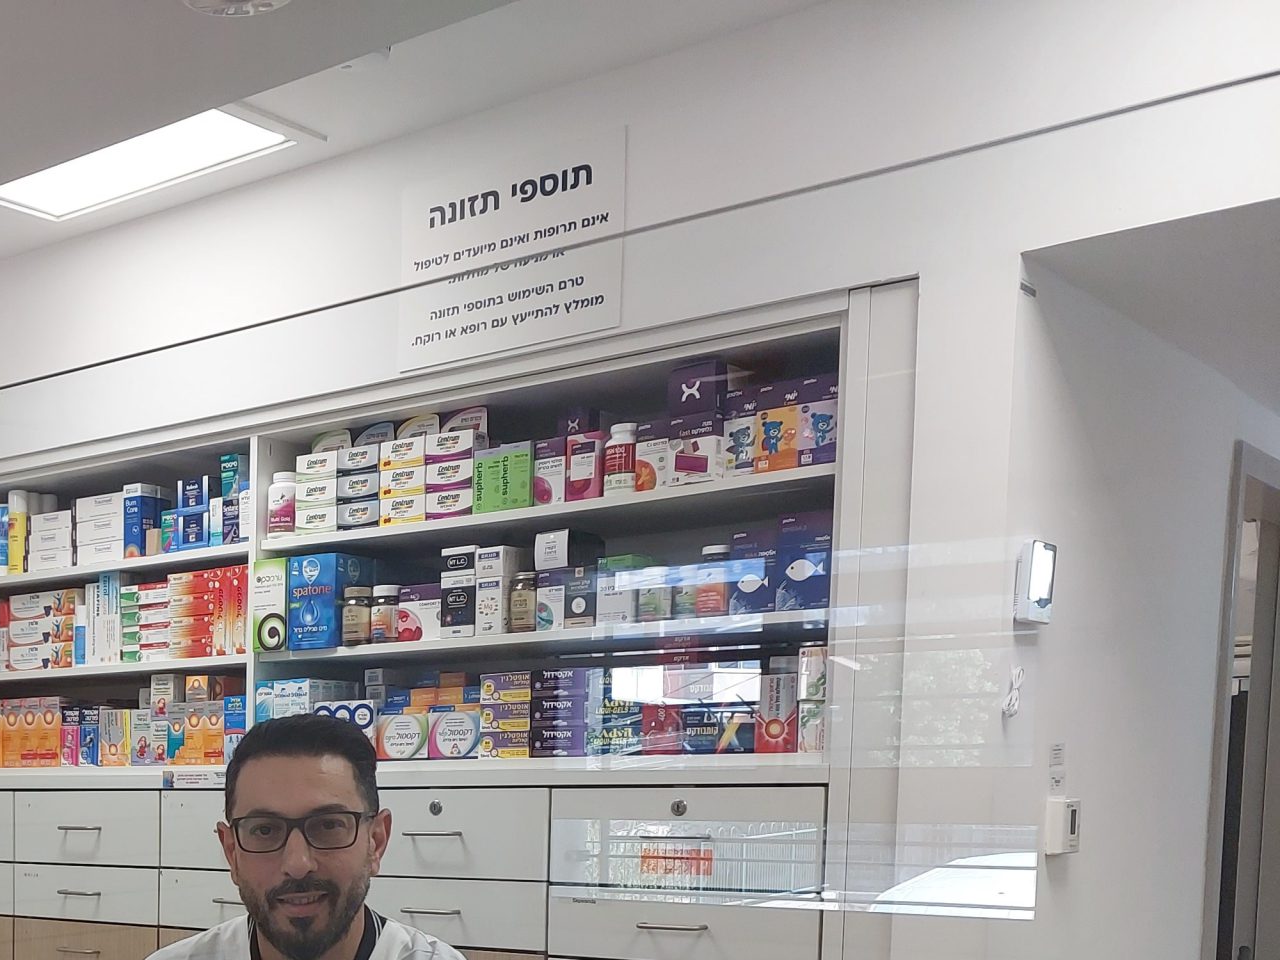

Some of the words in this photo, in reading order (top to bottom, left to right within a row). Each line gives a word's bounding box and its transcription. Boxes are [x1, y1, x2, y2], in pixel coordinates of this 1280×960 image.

[511, 164, 592, 202] תוספי
[430, 190, 500, 228] תזונה
[582, 212, 609, 228] אינם
[534, 221, 576, 240] תרופות
[501, 233, 529, 249] ואינם
[454, 242, 496, 262] מיועדים
[414, 254, 450, 271] לטיפול
[559, 275, 584, 291] טרם
[508, 283, 553, 302] השימוש
[464, 296, 503, 313] בתוספי
[564, 294, 604, 313] מומלץ
[430, 306, 460, 320] תזונה
[512, 304, 560, 324] להתייעץ
[460, 322, 487, 336] רופא
[491, 317, 508, 329] עם
[412, 331, 441, 346] רוקח.
[445, 328, 457, 339] או
[392, 441, 414, 450] Centrum
[437, 435, 460, 443] Centrum
[348, 450, 368, 459] Centrum
[307, 458, 327, 467] Centrum
[438, 464, 460, 473] Centrum
[392, 470, 414, 478] Centrum
[349, 479, 368, 487] Centrum
[475, 462, 483, 502] supherb
[306, 486, 326, 494] Centrum
[392, 499, 414, 507] Centrum
[437, 494, 460, 502] Centrum
[306, 513, 326, 521] Centrum
[349, 506, 368, 515] Centrum
[292, 584, 332, 599] spatone
[543, 701, 572, 709] אקסידול
[448, 728, 472, 736] דקסמול
[600, 728, 633, 737] Advil
